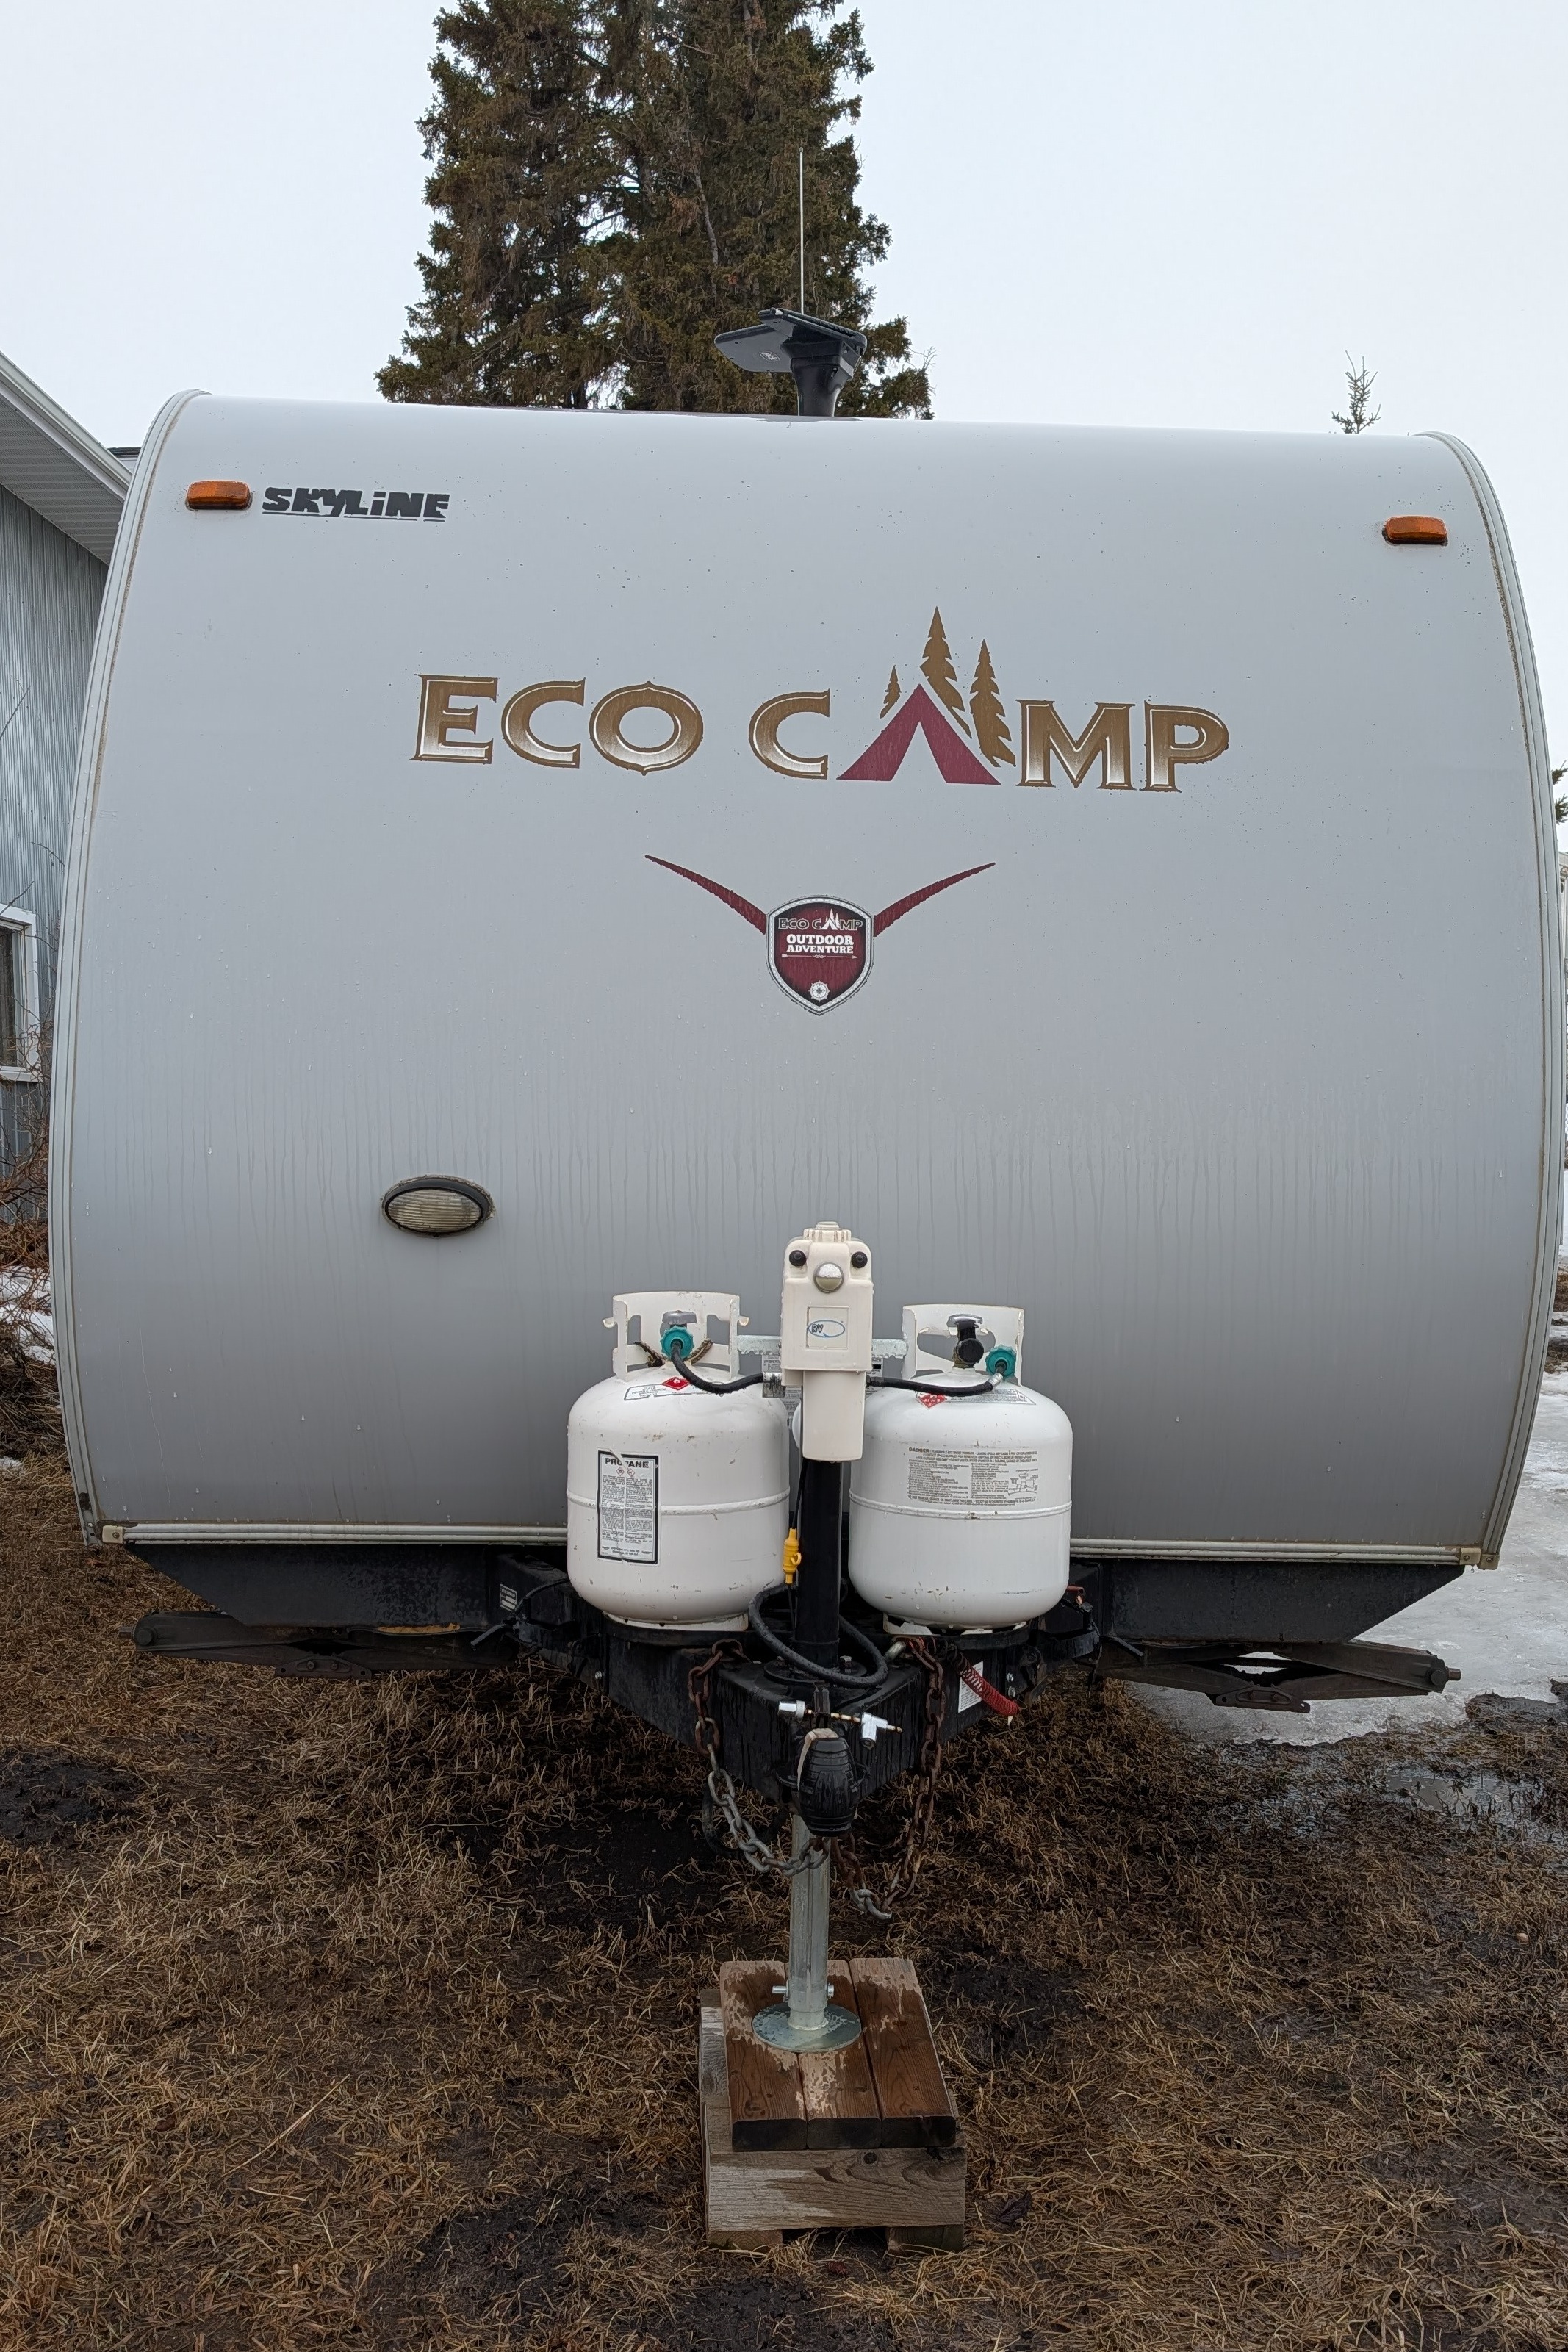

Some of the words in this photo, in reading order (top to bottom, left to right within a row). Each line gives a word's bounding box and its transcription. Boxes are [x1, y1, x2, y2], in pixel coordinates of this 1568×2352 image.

[410, 672, 705, 777] ECO
[748, 683, 1230, 792] CAMP
[778, 918, 809, 930] ECO
[812, 918, 863, 931] CAMP
[786, 933, 854, 946] OUTDOOR
[786, 945, 854, 954] ADVENTURE
